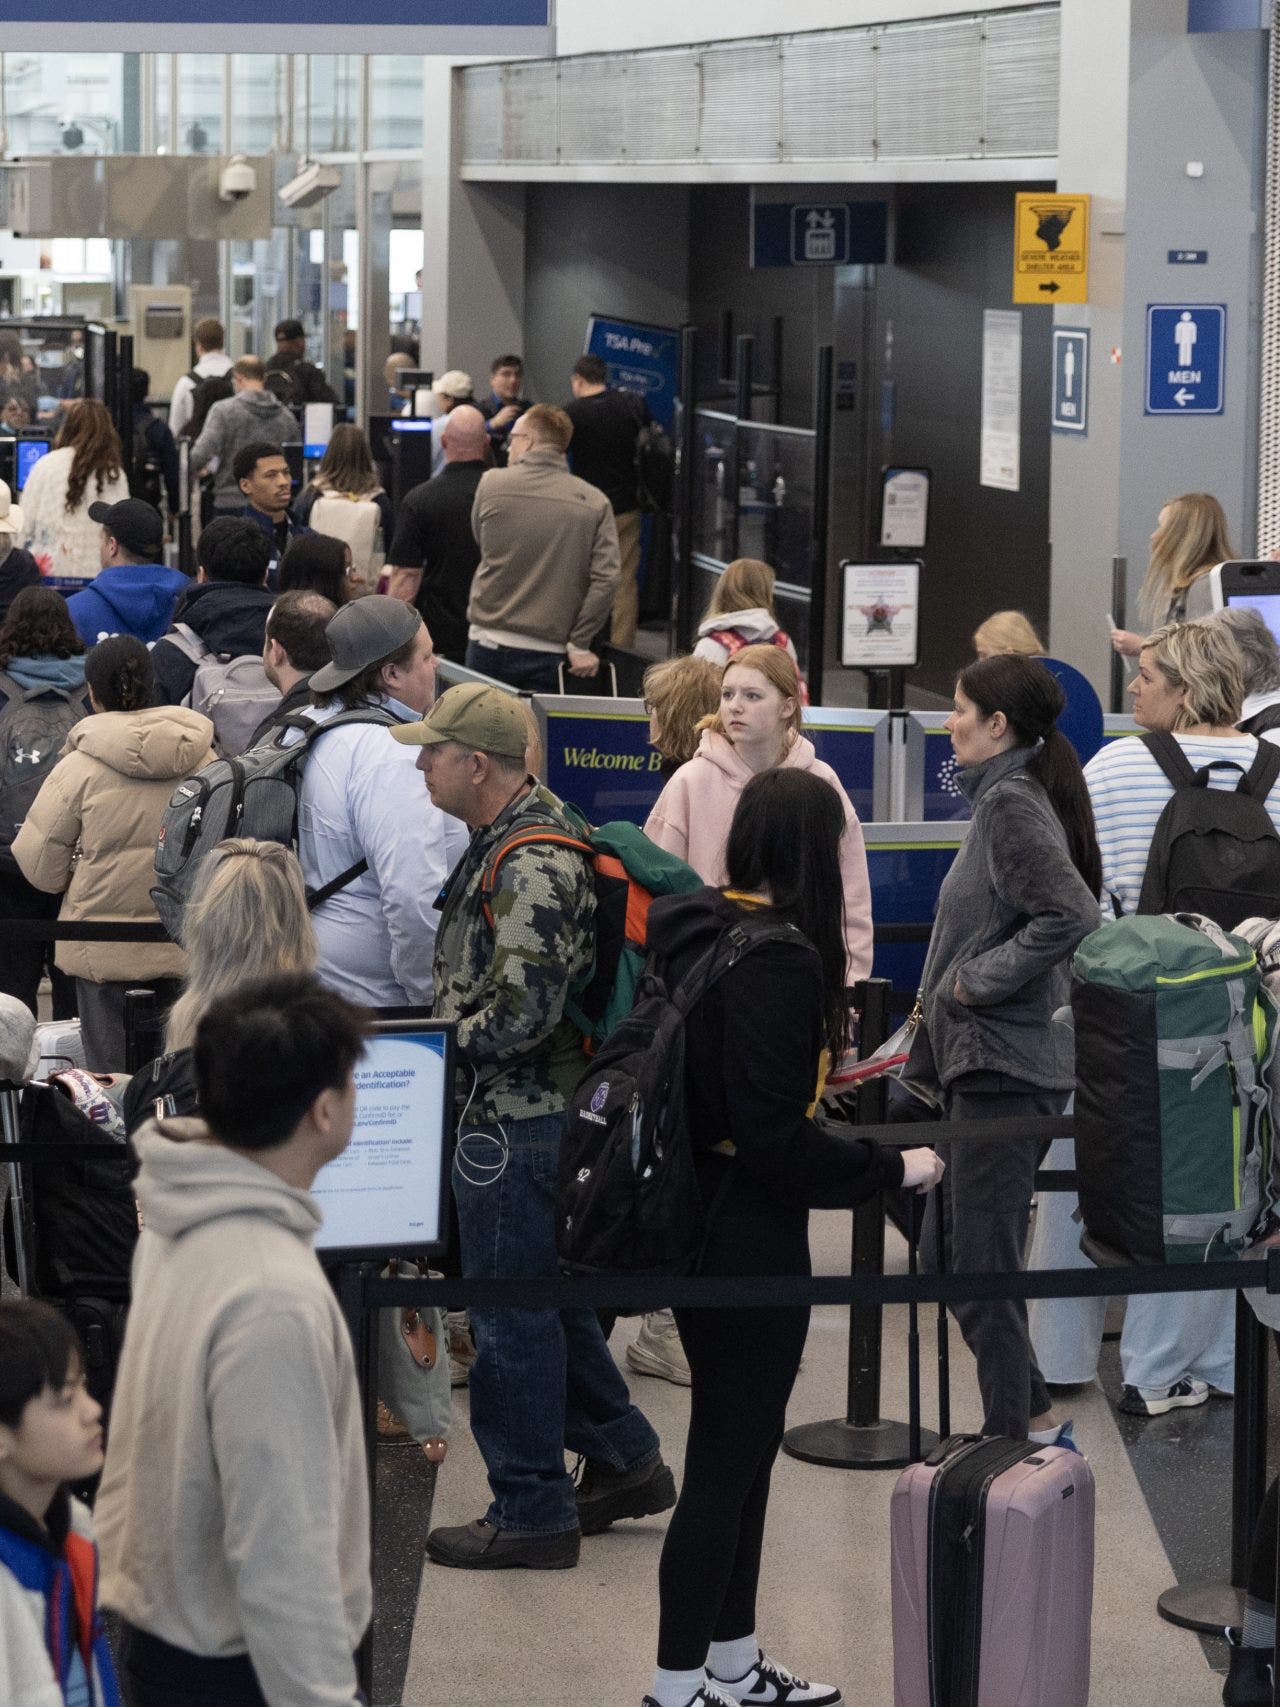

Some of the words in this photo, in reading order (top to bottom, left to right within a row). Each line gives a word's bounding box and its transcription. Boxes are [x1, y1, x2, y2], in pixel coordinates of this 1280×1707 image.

[605, 332, 629, 351] TSA
[1168, 370, 1202, 384] MEN
[563, 747, 645, 771] Welcome
[372, 1068, 416, 1079] Acceptable
[356, 1080, 410, 1090] dentification?
[580, 1109, 607, 1125] BASKETBALL
